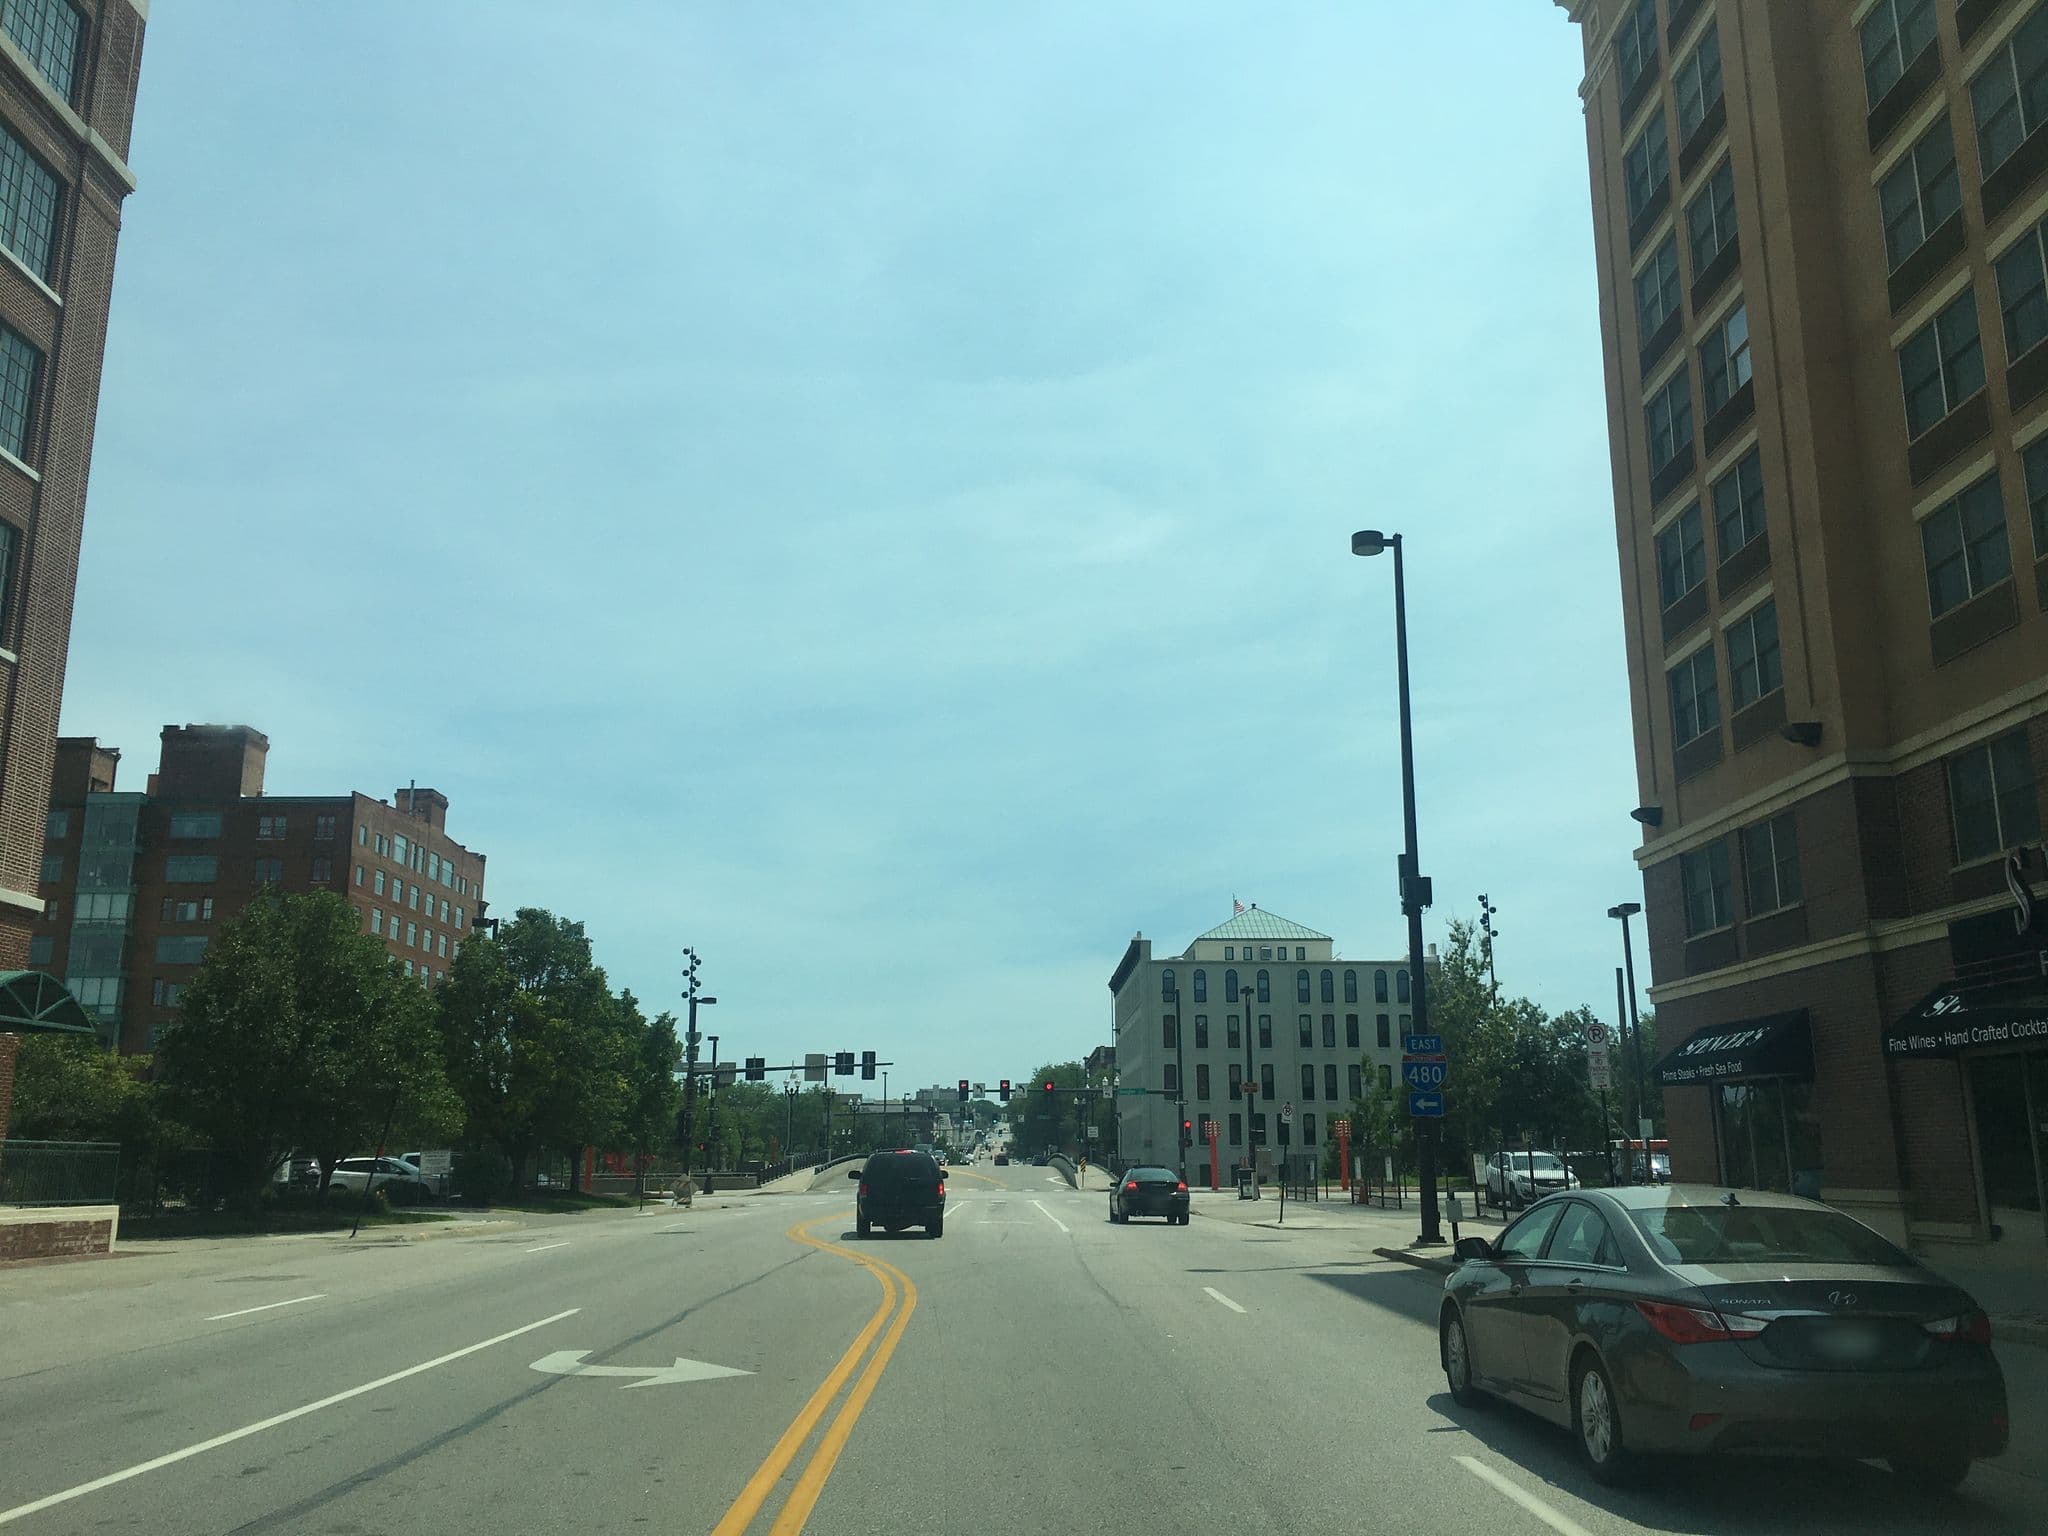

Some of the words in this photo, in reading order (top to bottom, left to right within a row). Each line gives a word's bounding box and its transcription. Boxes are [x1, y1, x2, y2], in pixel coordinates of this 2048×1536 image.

[1411, 1039, 1437, 1050] EAST
[1889, 1038, 1907, 1052] Fine
[1909, 1034, 1936, 1049] Wines
[1944, 1029, 1969, 1046] Hand
[1972, 1022, 2008, 1043] Crafted
[1409, 1066, 1442, 1083] 480
[1715, 1063, 1727, 1076] Sea
[1727, 1060, 1742, 1073] Food
